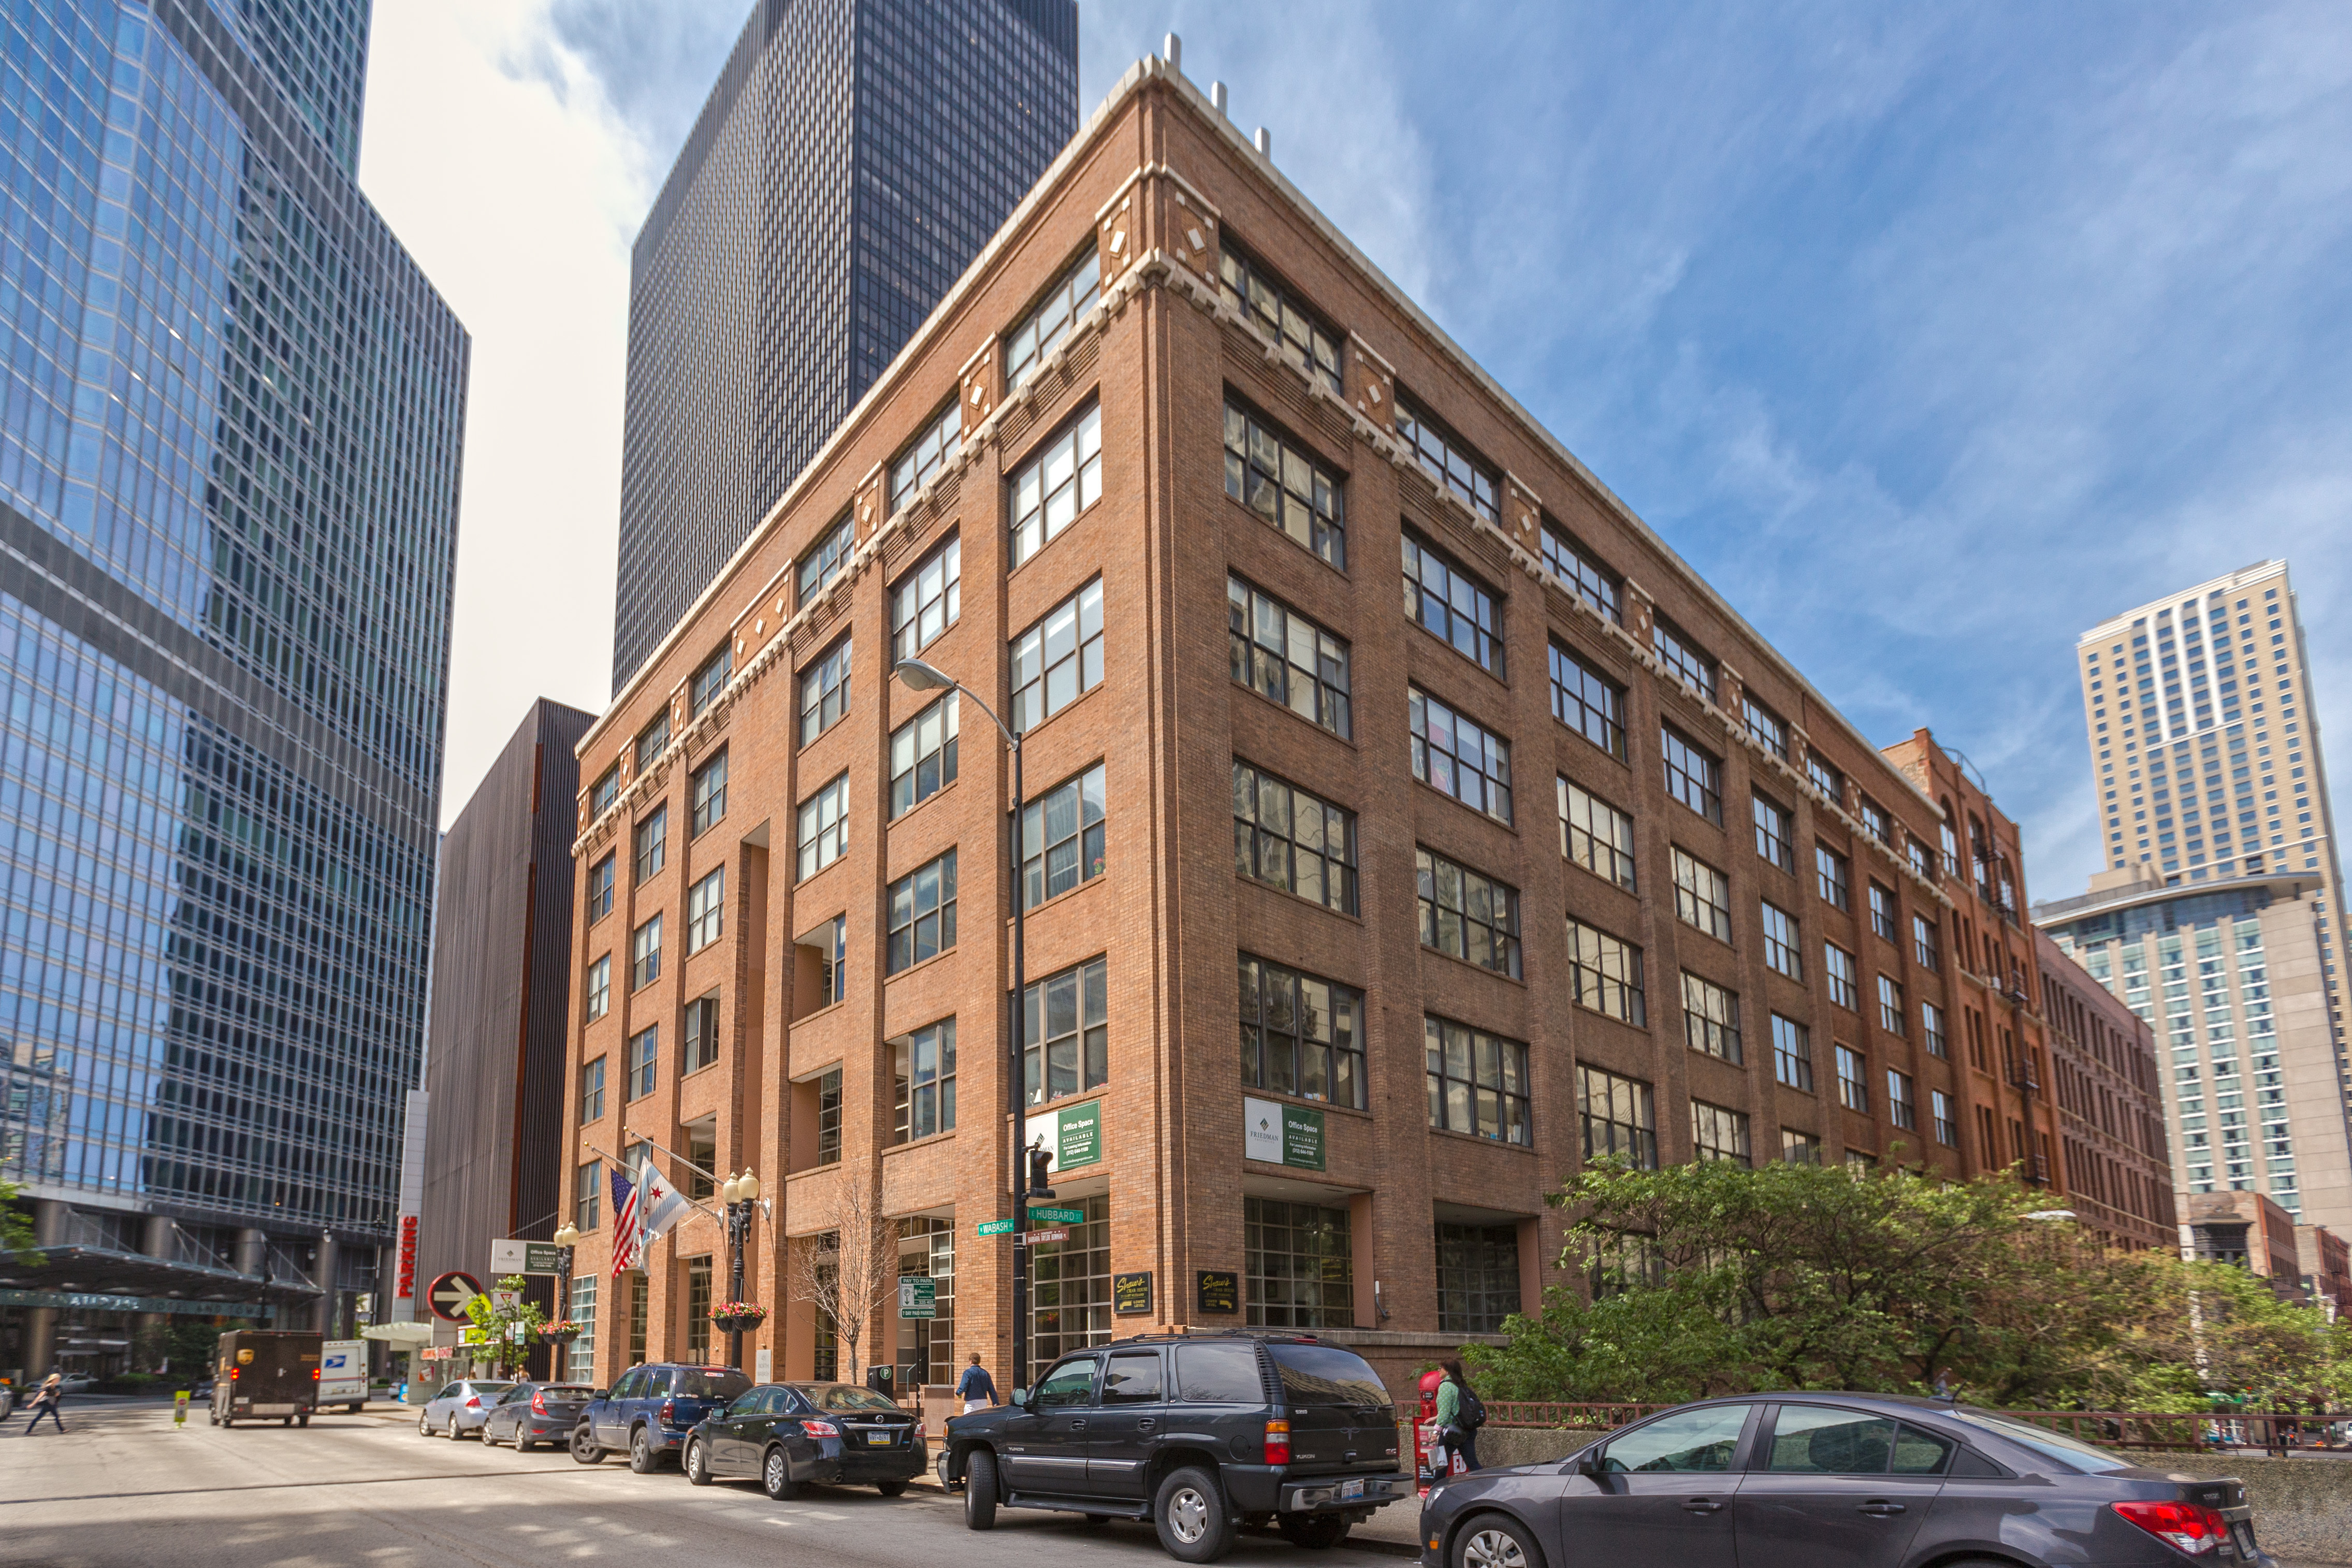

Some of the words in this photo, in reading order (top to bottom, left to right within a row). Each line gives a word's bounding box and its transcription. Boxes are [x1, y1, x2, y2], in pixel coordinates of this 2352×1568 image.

[1063, 1123, 1077, 1131] Office
[1078, 1119, 1094, 1129] Space
[1288, 1121, 1302, 1130] Office
[1303, 1124, 1318, 1133] Space
[1063, 1132, 1093, 1143] AVAILABLE
[1251, 1131, 1279, 1141] FRIEDMAN
[1289, 1135, 1317, 1144] AVAILABLE
[1036, 1210, 1075, 1221] HUBBARD
[983, 1222, 1008, 1233] WABASH
[398, 1216, 418, 1298] PARKING
[1116, 1276, 1145, 1293] Shaw's
[1203, 1275, 1231, 1290] Shaw's
[883, 1369, 889, 1377] P
